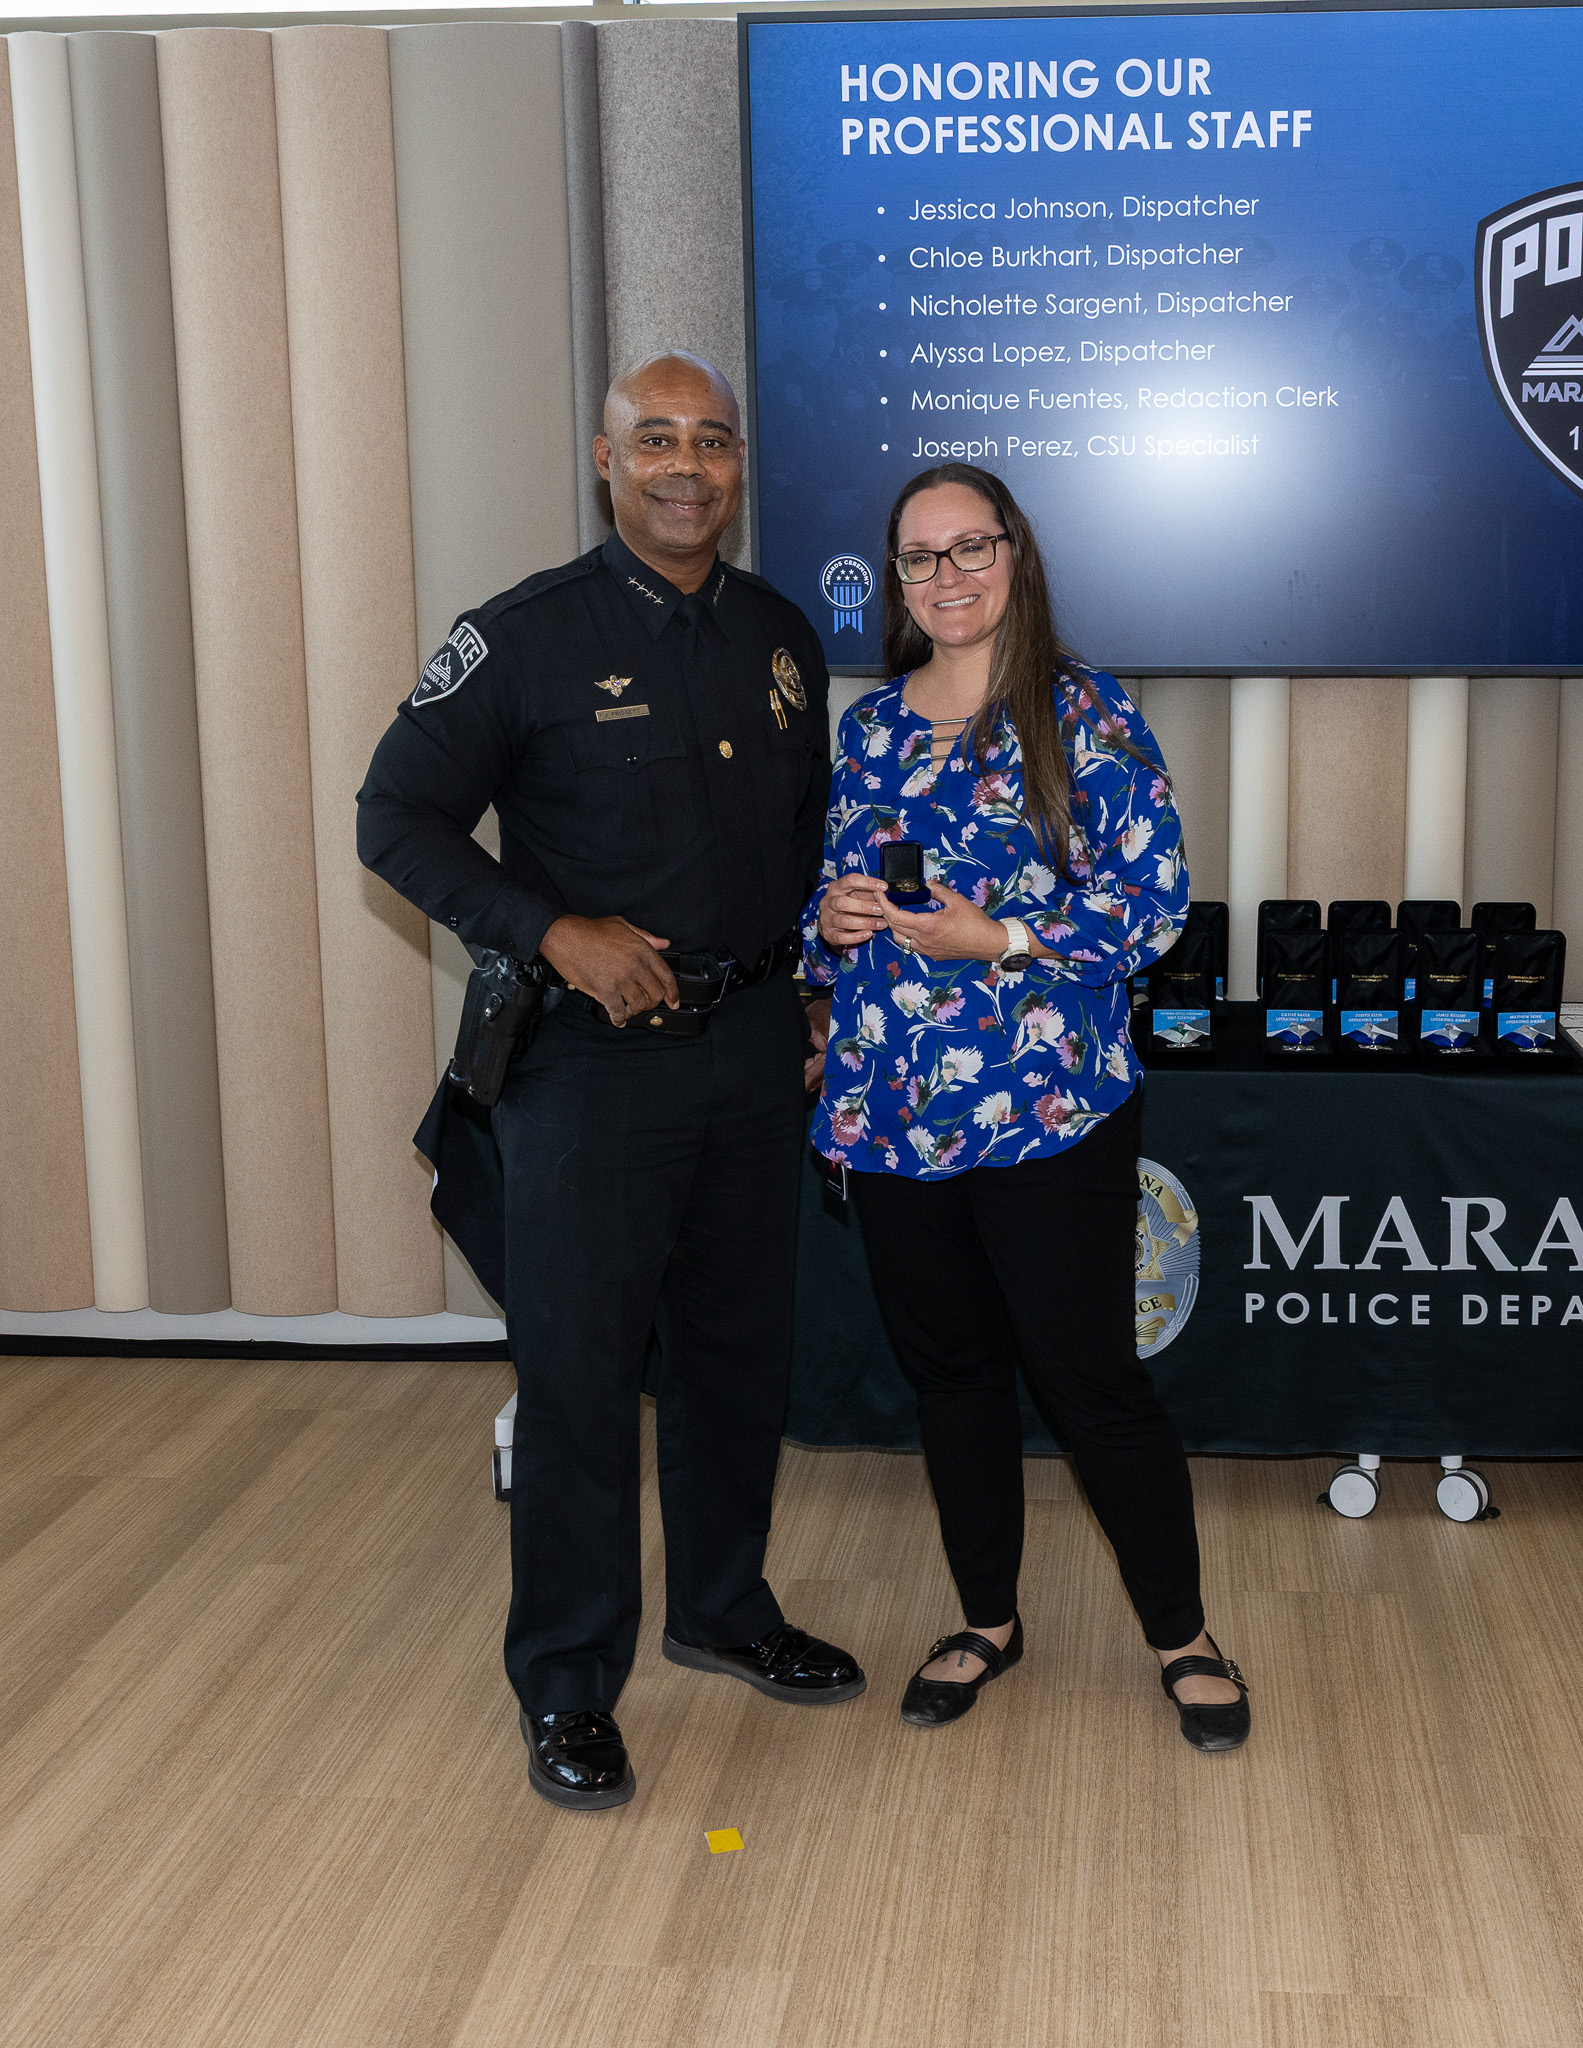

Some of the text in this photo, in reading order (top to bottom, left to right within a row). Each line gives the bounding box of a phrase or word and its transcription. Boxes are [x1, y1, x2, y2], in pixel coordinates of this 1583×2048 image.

[840, 57, 1212, 102] HONORING OUR
[841, 110, 1312, 156] PROFESSIONAL STAFF
[908, 194, 1260, 222] Jessica Johnson, Dispatcher
[909, 242, 1244, 270] Chloe Burkhart, Dispatcher
[910, 290, 1294, 319] Nicholette Sargent, Dispatcher
[910, 340, 1216, 368] Alyssa Lopez, Dispatcher
[911, 385, 1340, 415] Monique Fuentes, Redaction Clerk
[1521, 381, 1583, 403] MAR
[911, 433, 1260, 462] Joseph Perez, CSU Specialist
[825, 559, 870, 586] AWARDS CEREMONY
[447, 627, 481, 671] OLICE
[437, 680, 449, 691] AZ
[1245, 1292, 1430, 1326] POLICE
